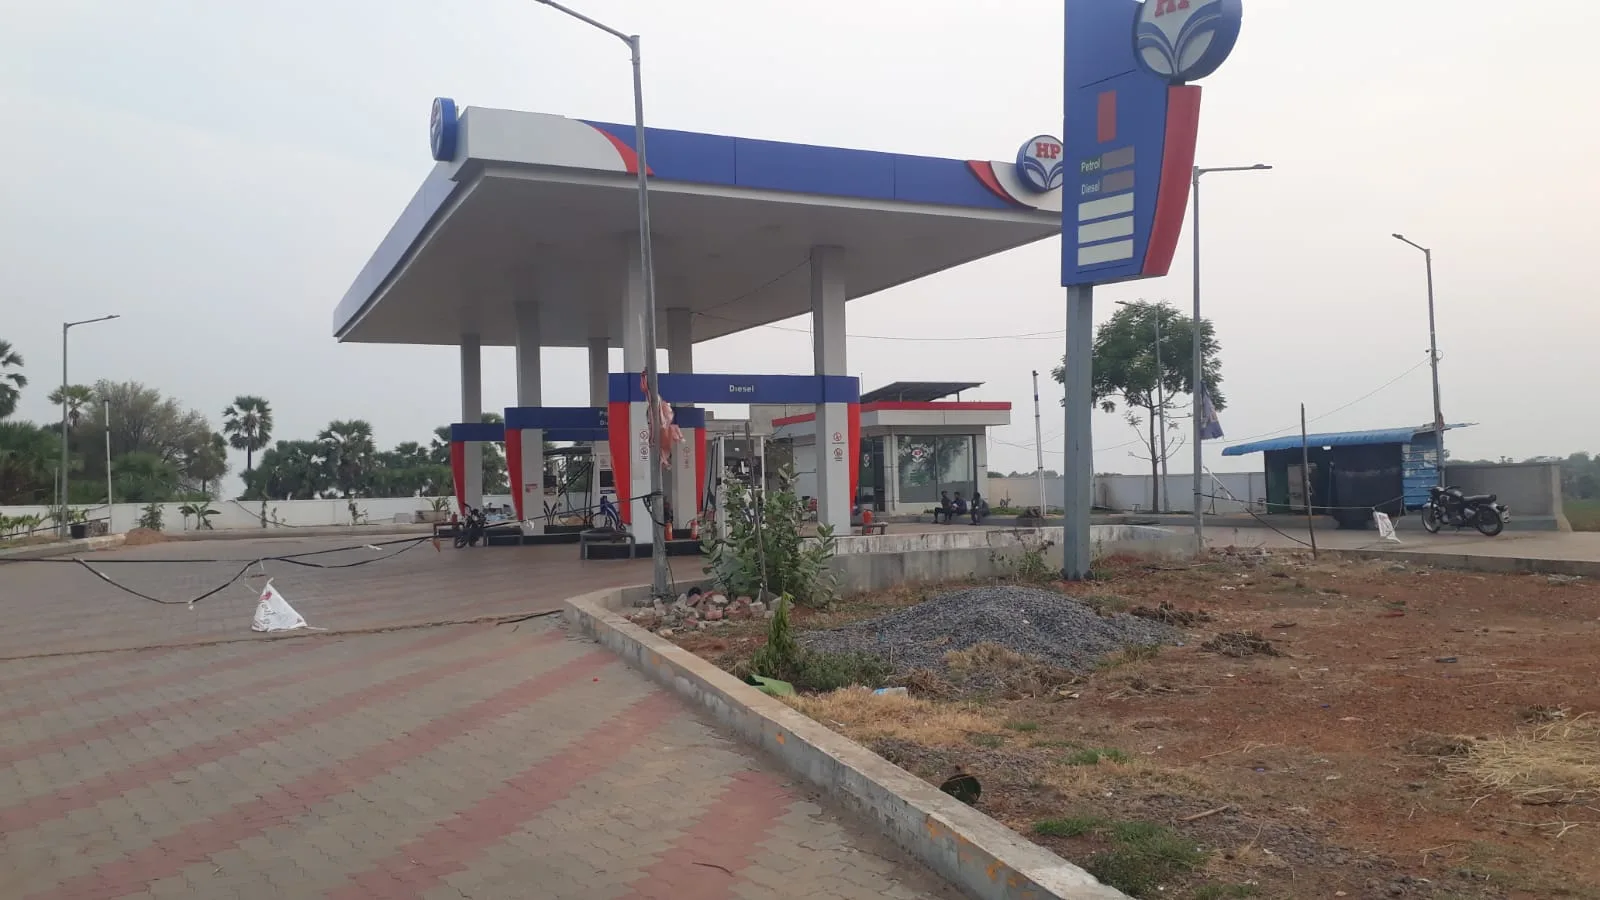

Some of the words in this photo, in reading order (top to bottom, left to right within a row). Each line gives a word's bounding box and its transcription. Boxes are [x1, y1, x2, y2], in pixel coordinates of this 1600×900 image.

[1035, 142, 1061, 159] HP
[1080, 158, 1101, 172] Petrol
[1081, 180, 1101, 195] Diesel
[729, 384, 755, 393] Diesel
